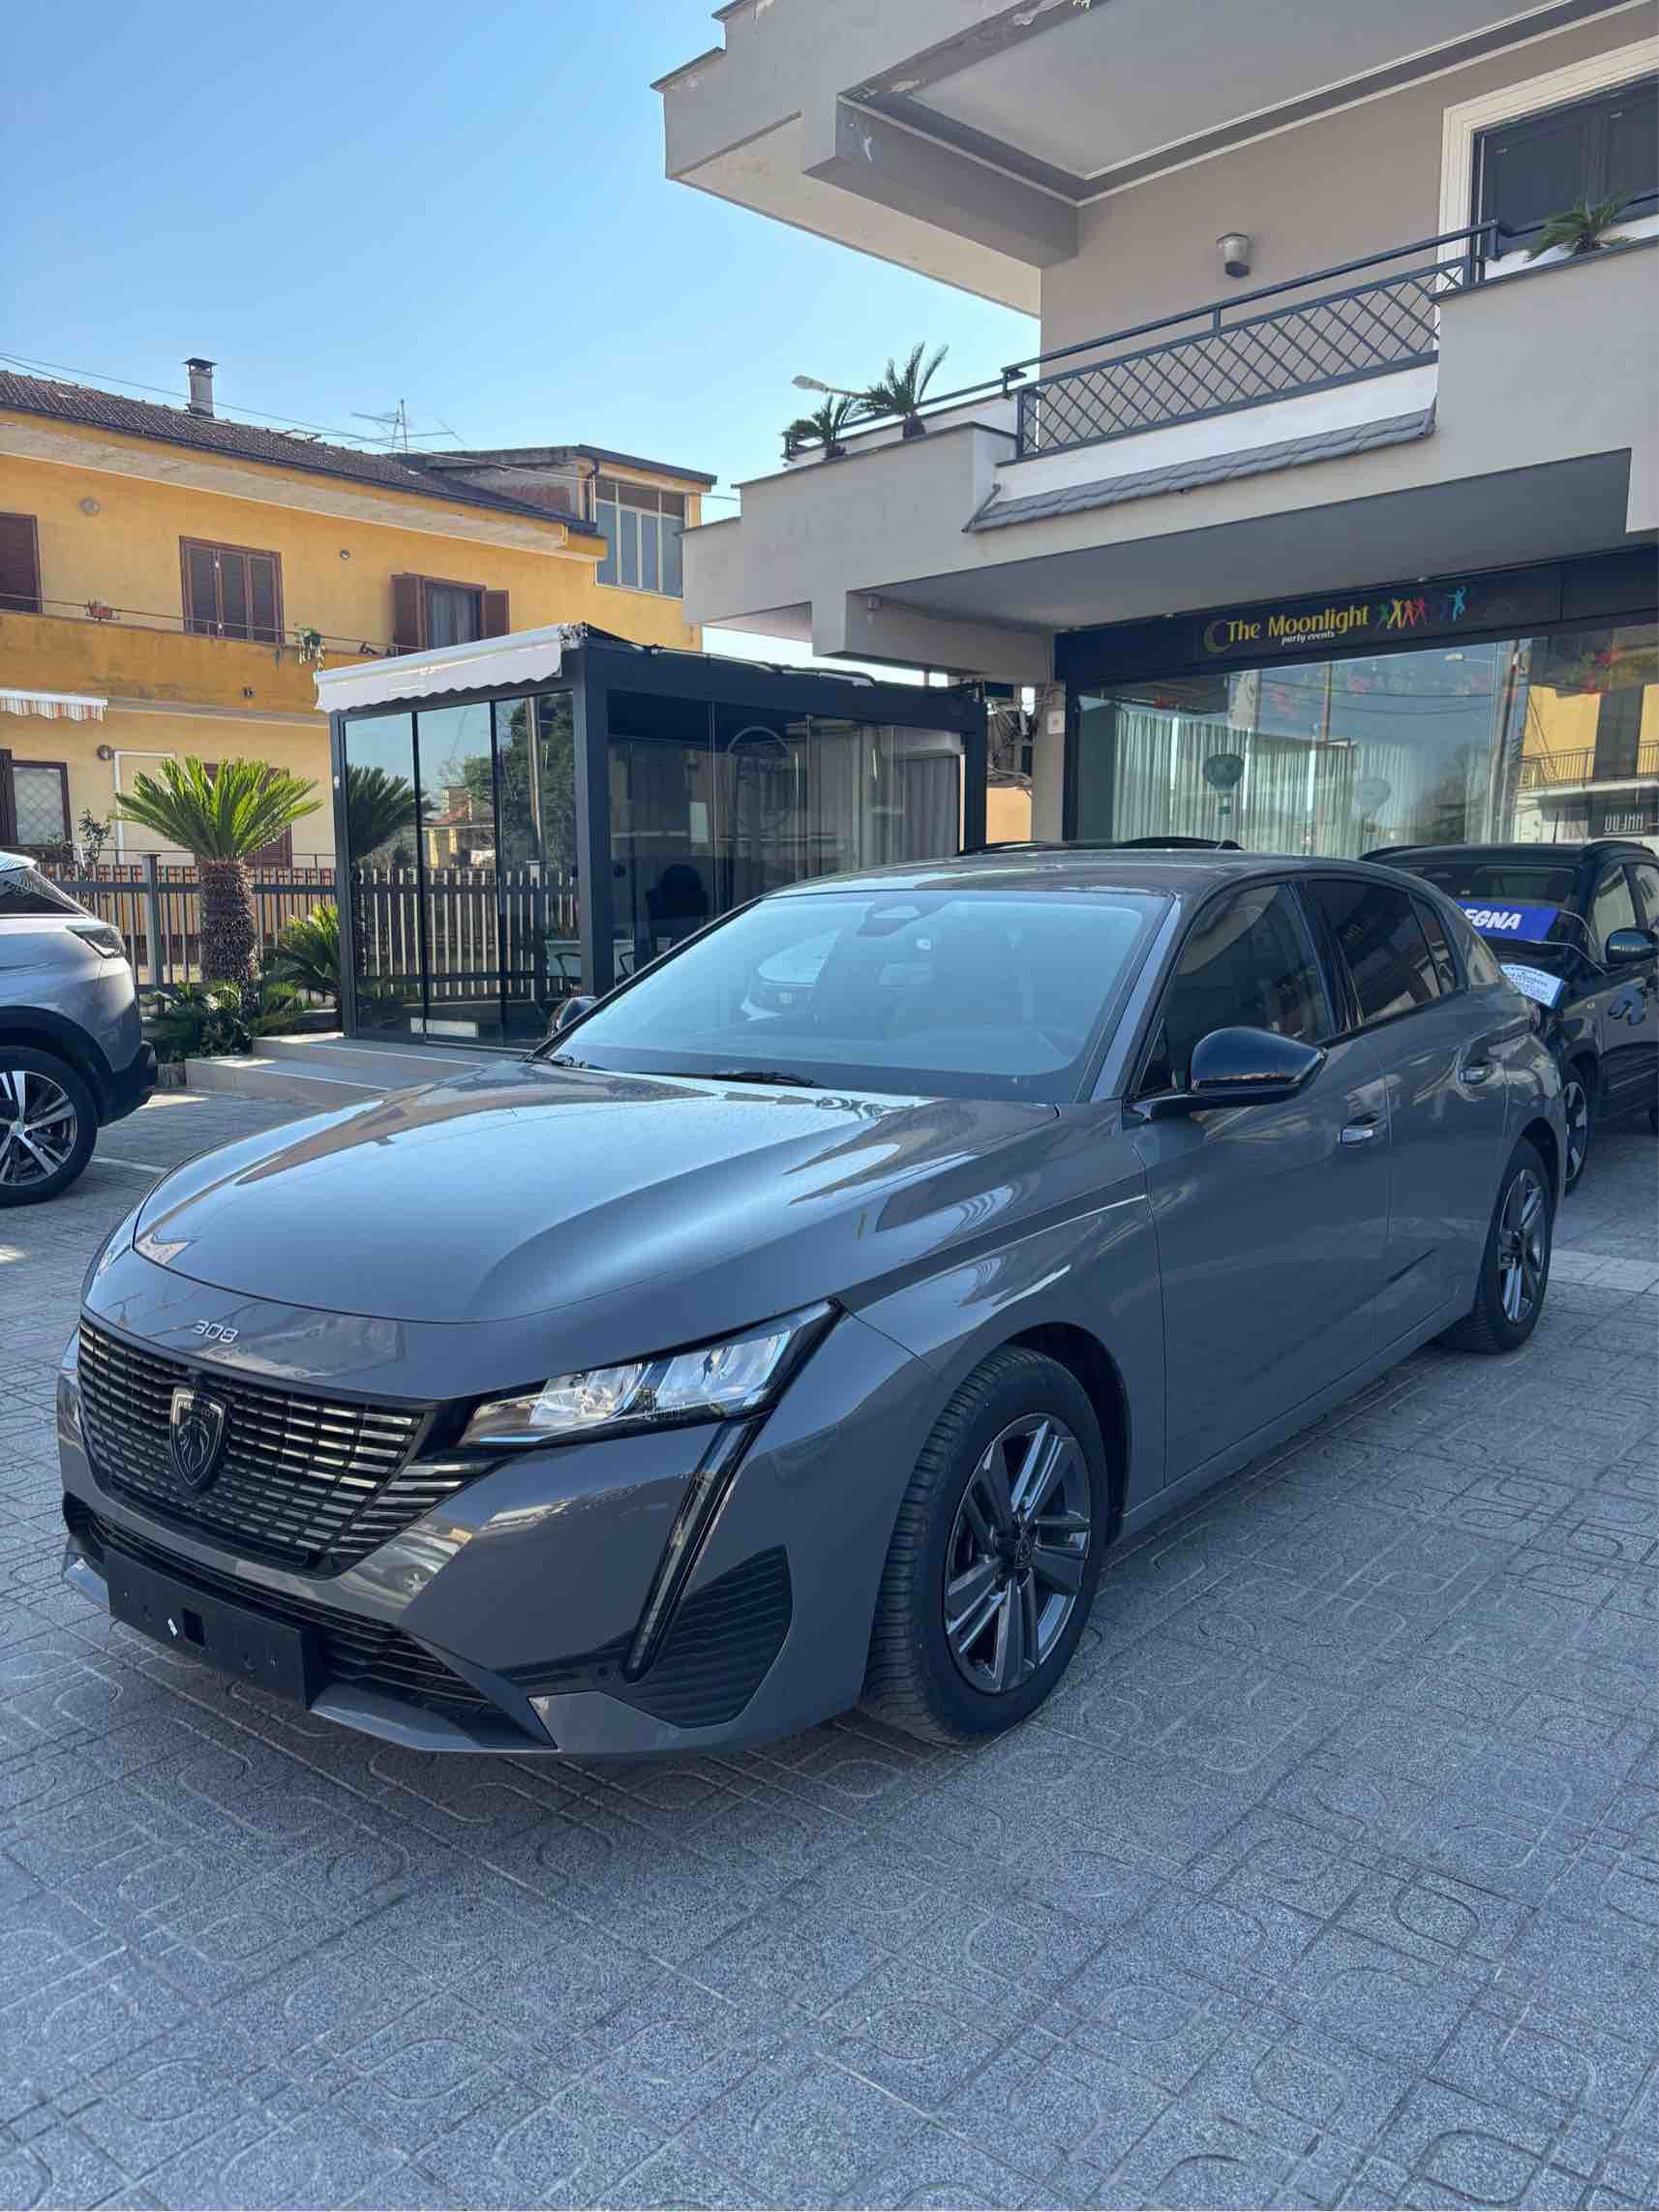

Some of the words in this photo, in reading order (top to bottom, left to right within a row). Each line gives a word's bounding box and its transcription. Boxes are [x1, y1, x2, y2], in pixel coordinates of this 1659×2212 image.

[1226, 620, 1260, 643] The
[1268, 604, 1370, 636] Moonlight
[1281, 633, 1306, 646] party
[1307, 630, 1335, 641] events
[193, 1319, 239, 1344] 308
